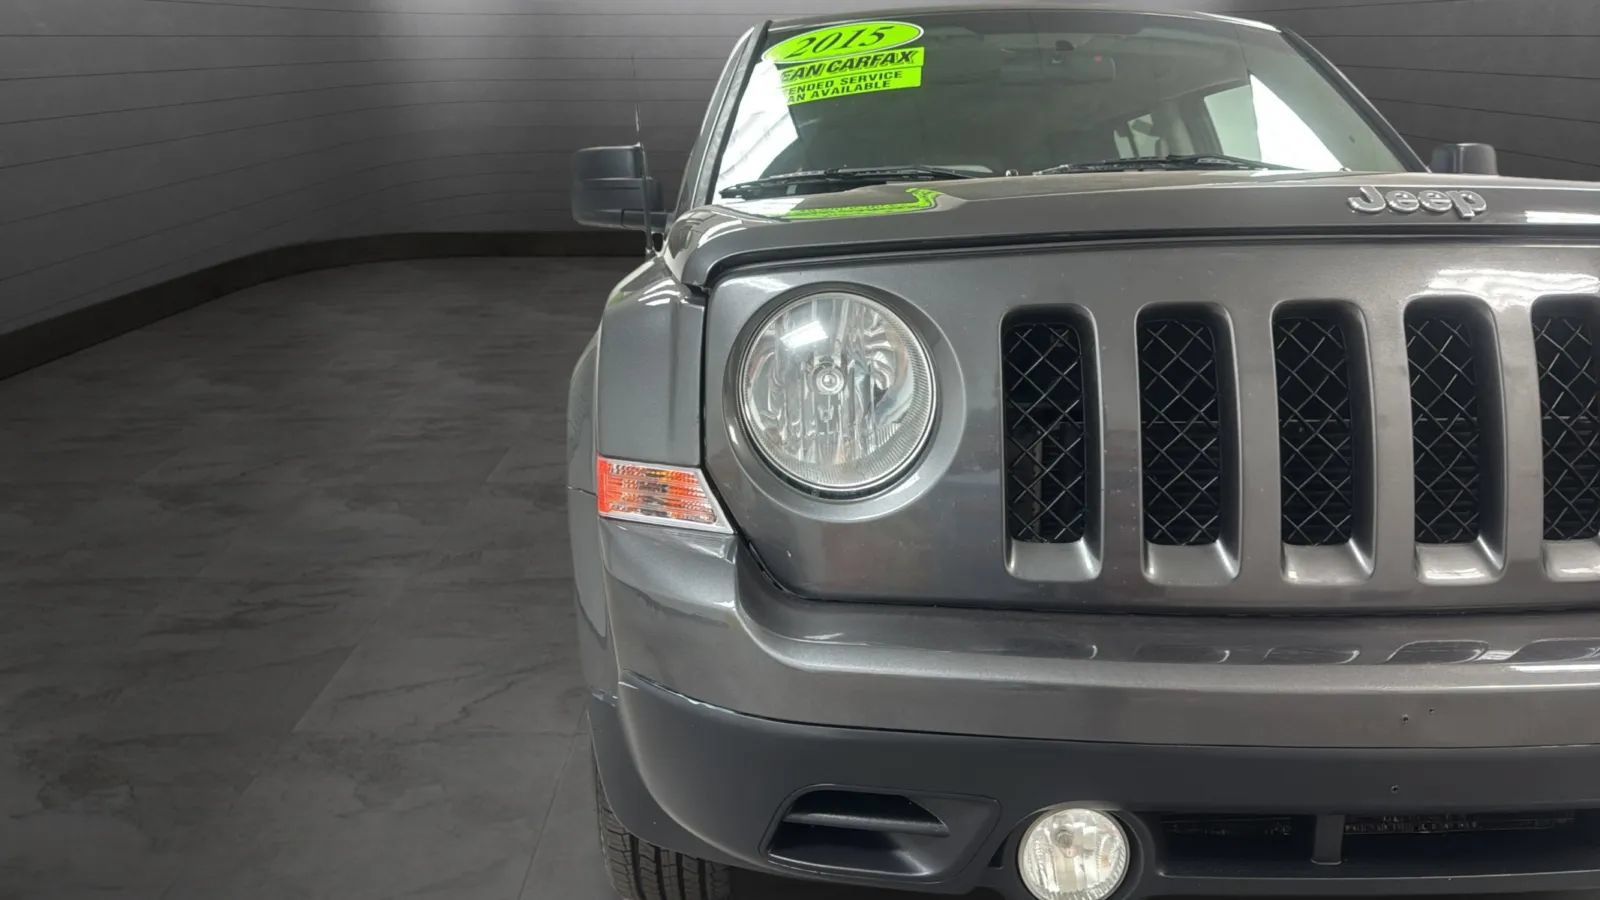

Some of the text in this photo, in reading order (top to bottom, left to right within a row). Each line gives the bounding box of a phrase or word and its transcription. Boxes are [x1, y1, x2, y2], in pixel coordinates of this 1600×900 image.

[785, 26, 895, 59] 2015
[781, 51, 917, 82] EAN CARFAX
[788, 70, 903, 96] ENDED SERVICE
[811, 80, 891, 99] AVAILABLE
[1348, 186, 1487, 218] Jeep
